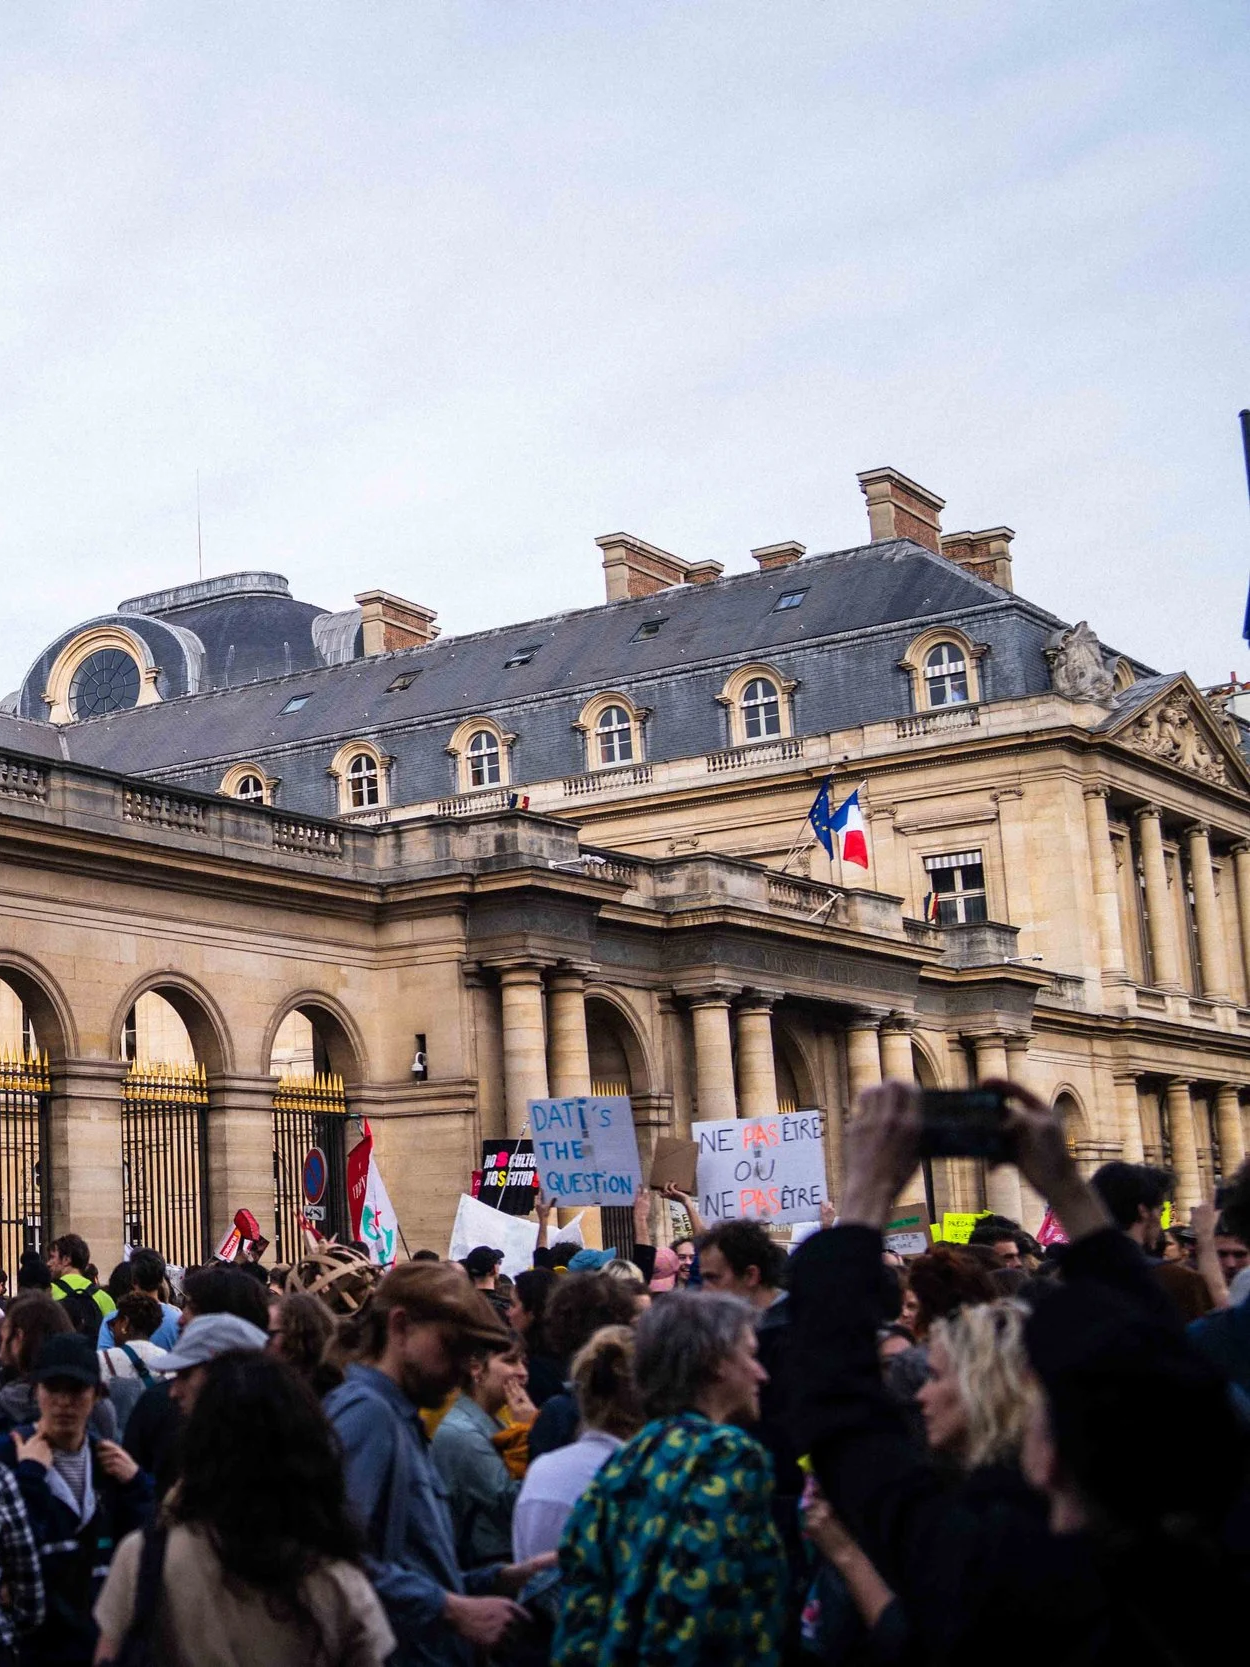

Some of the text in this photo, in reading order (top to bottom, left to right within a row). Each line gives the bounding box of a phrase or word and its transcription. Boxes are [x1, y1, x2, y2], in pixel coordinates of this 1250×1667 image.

[700, 1116, 822, 1154] NE PAS ÊTRE
[484, 1151, 538, 1169] NOS CULTU
[539, 1141, 584, 1160] THE
[484, 1170, 507, 1187] NOS
[735, 1159, 775, 1181] OU
[705, 1185, 822, 1219] NE PAS ÊTRE
